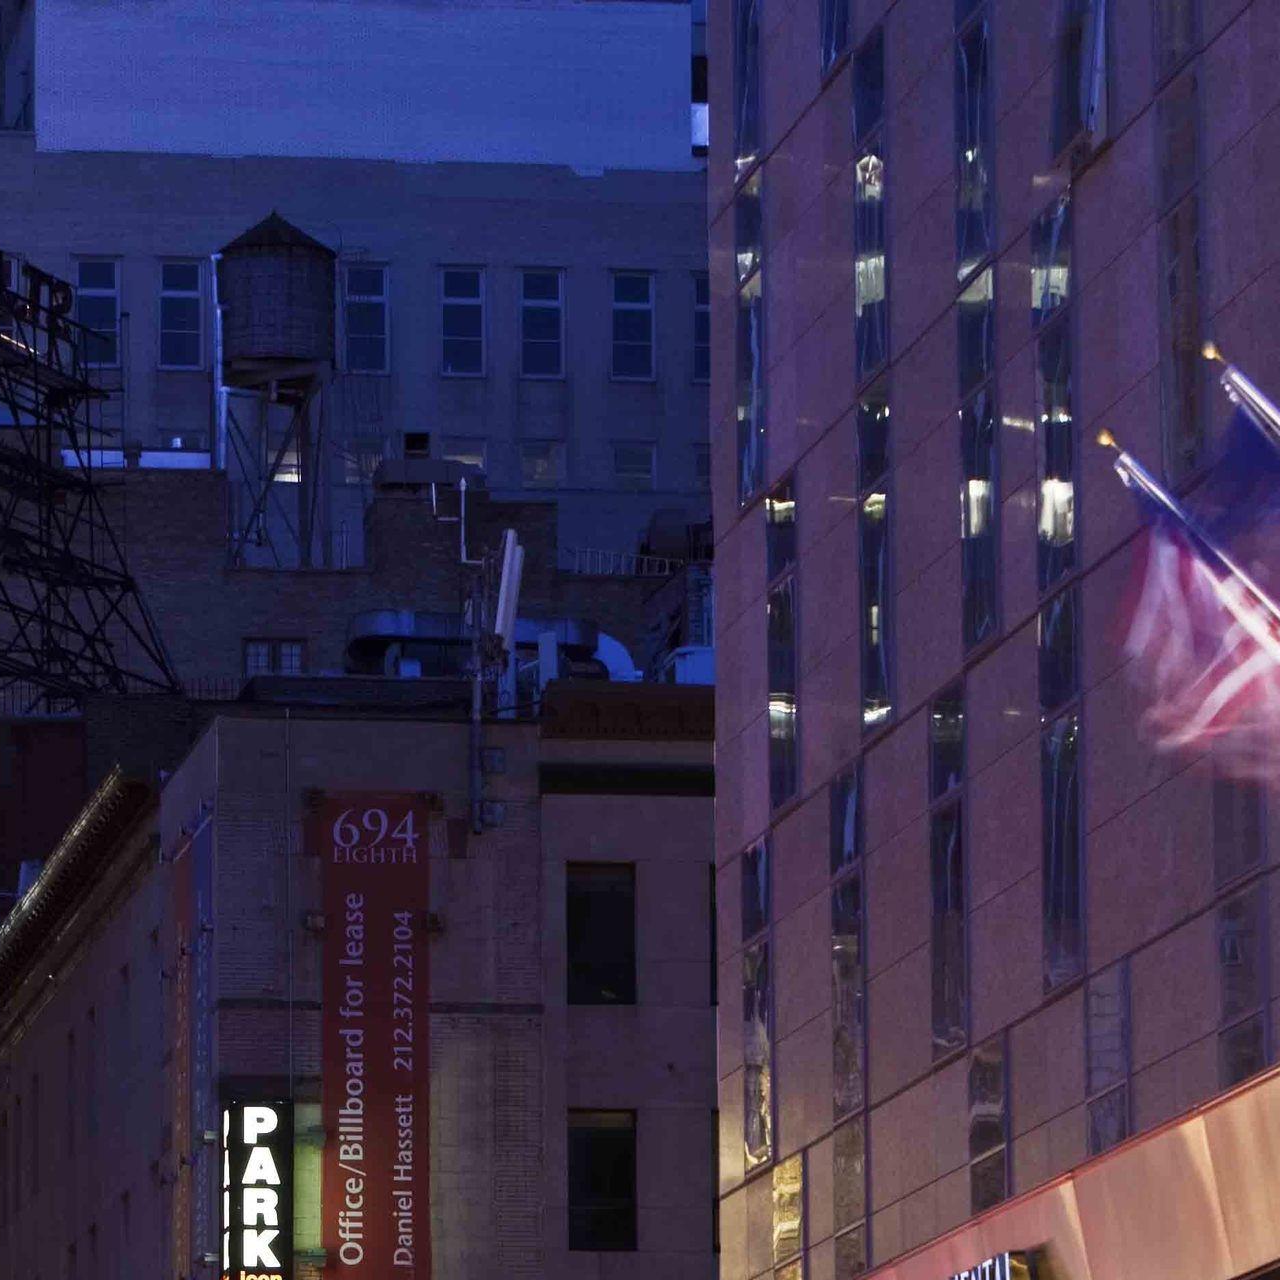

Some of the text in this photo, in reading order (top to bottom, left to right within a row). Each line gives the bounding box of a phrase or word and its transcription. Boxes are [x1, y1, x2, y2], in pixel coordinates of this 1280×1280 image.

[332, 808, 420, 849] 694
[332, 847, 418, 864] EIGHTH
[338, 892, 367, 1266] Office/Billboard for lease
[392, 910, 414, 1267] Daniel Hassett 212.372.2104
[241, 1106, 282, 1268] PARK
